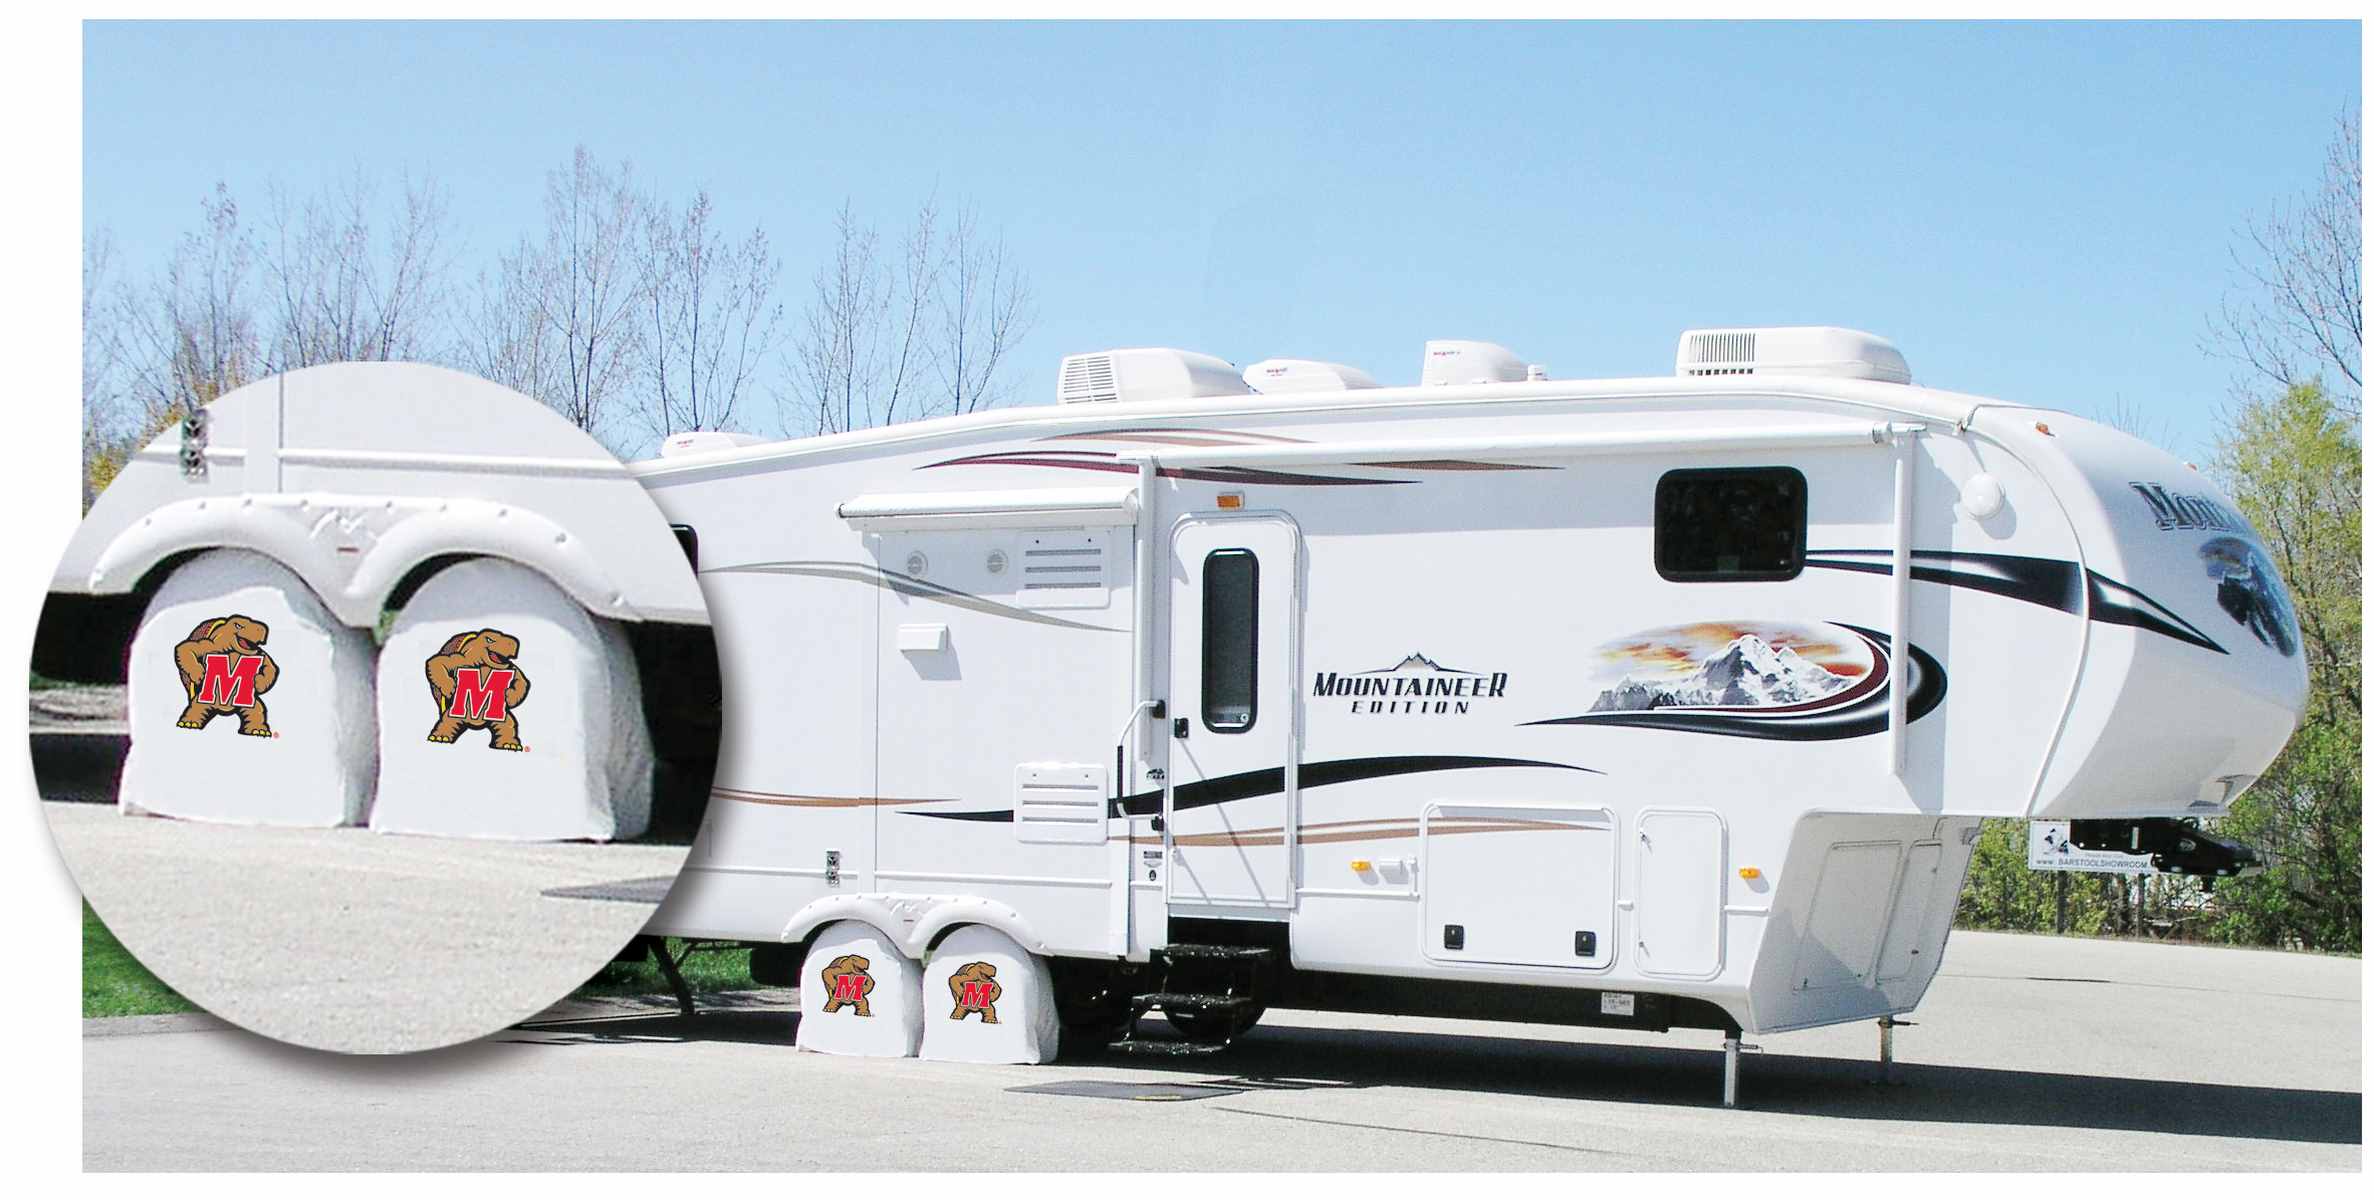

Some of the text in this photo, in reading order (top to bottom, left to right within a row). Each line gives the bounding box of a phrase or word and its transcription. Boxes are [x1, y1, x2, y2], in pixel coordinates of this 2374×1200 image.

[198, 654, 263, 707] M
[1313, 672, 1508, 698] MOUNTAINEER
[449, 668, 514, 721] M
[1351, 700, 1469, 714] EDITION
[834, 974, 866, 1002] M
[961, 982, 993, 1009] M
